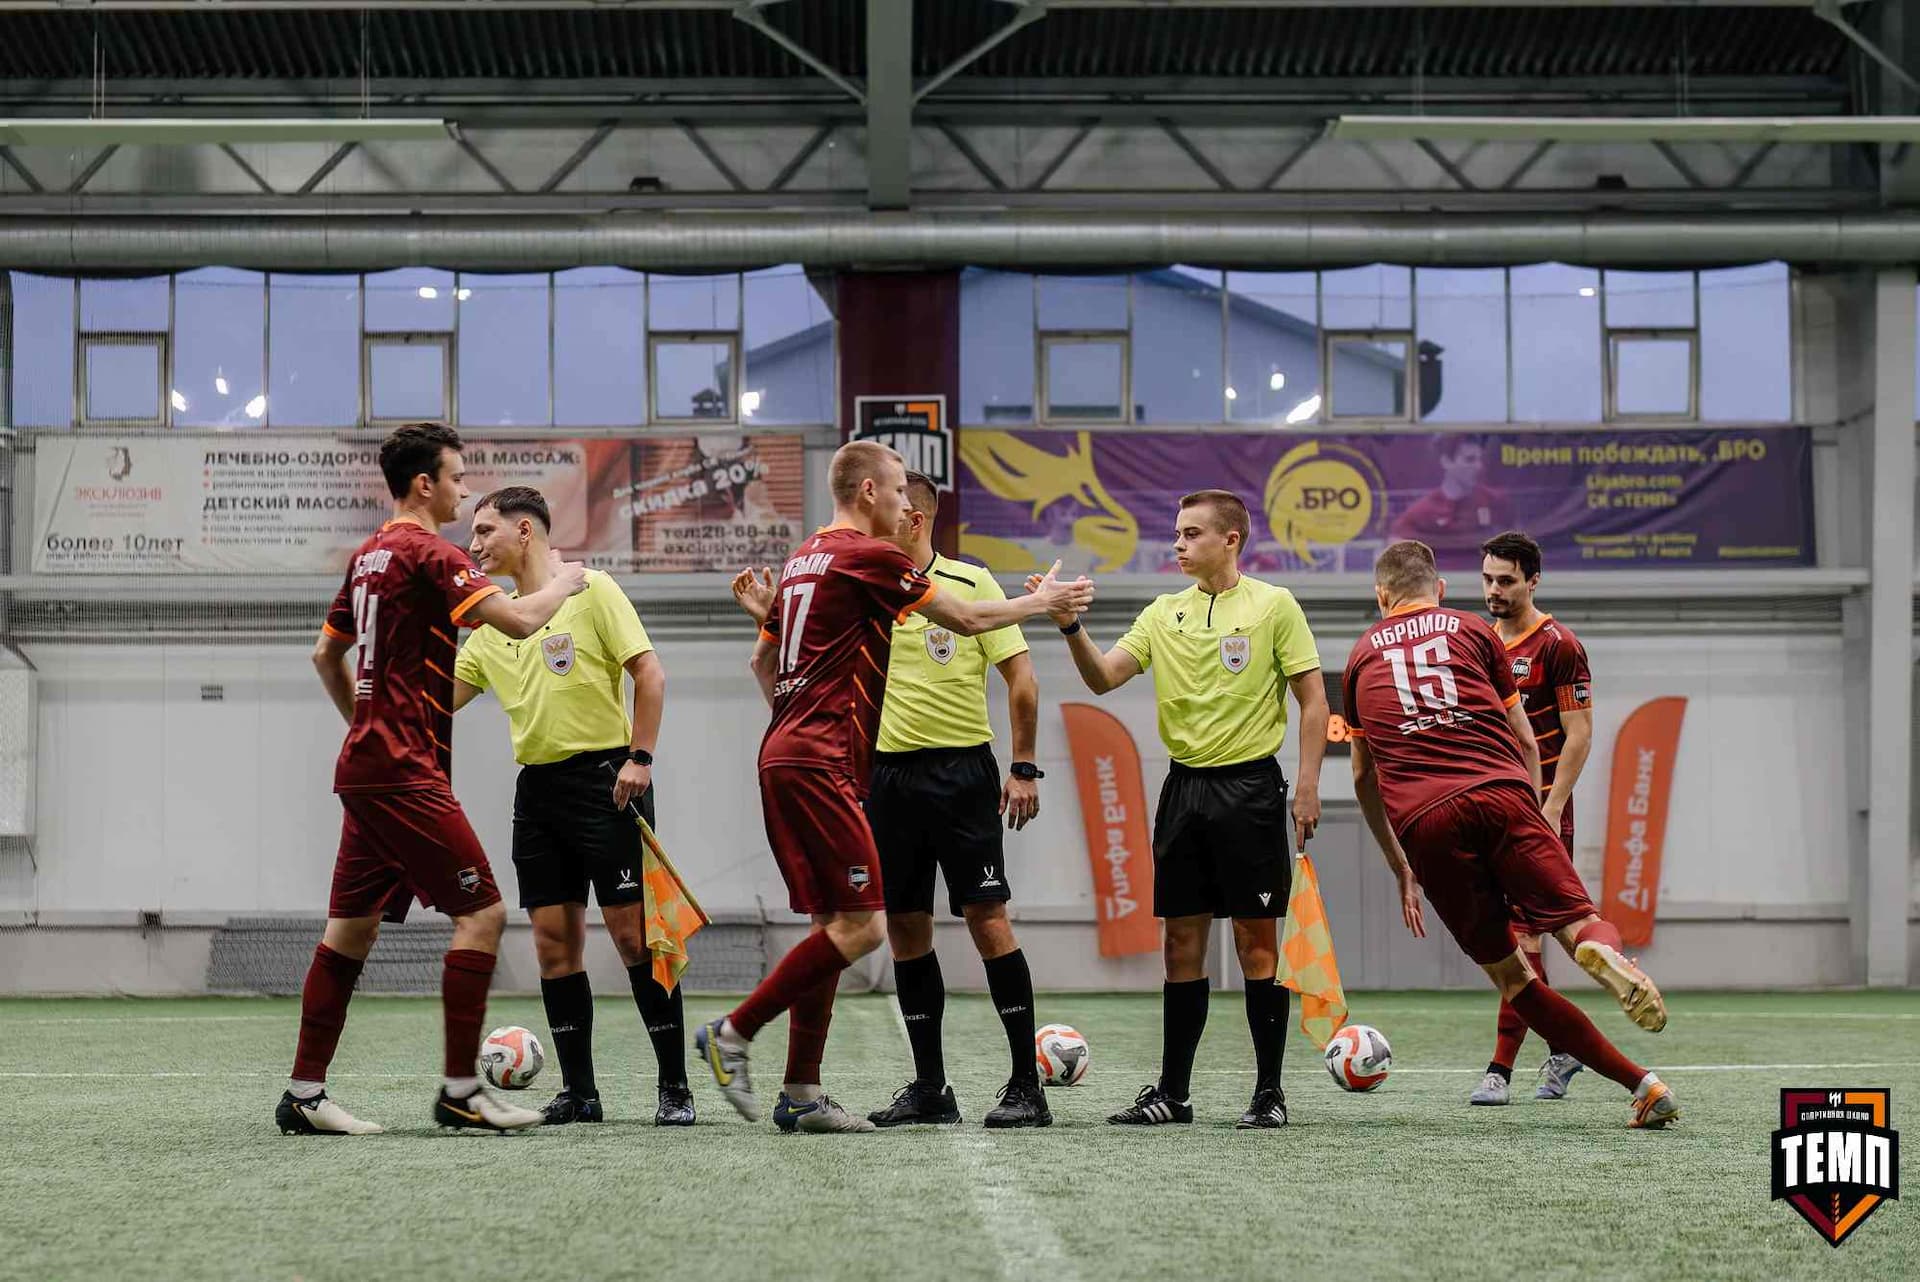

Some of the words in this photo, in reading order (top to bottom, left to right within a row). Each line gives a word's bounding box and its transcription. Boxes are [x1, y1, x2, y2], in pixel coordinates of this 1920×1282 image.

[1501, 443, 1572, 467] Время
[712, 456, 770, 490] 20%
[76, 487, 162, 500] ЭКСКЛЮЗИВ
[203, 493, 290, 511] ДЕТСКИЙ
[1295, 487, 1361, 510] .БРО
[47, 531, 113, 551] более
[779, 582, 816, 674] 17
[1370, 614, 1460, 649] АБРАМОВ
[1382, 635, 1459, 715] 15
[1627, 747, 1656, 816] Банк
[1617, 820, 1650, 911] Альфа
